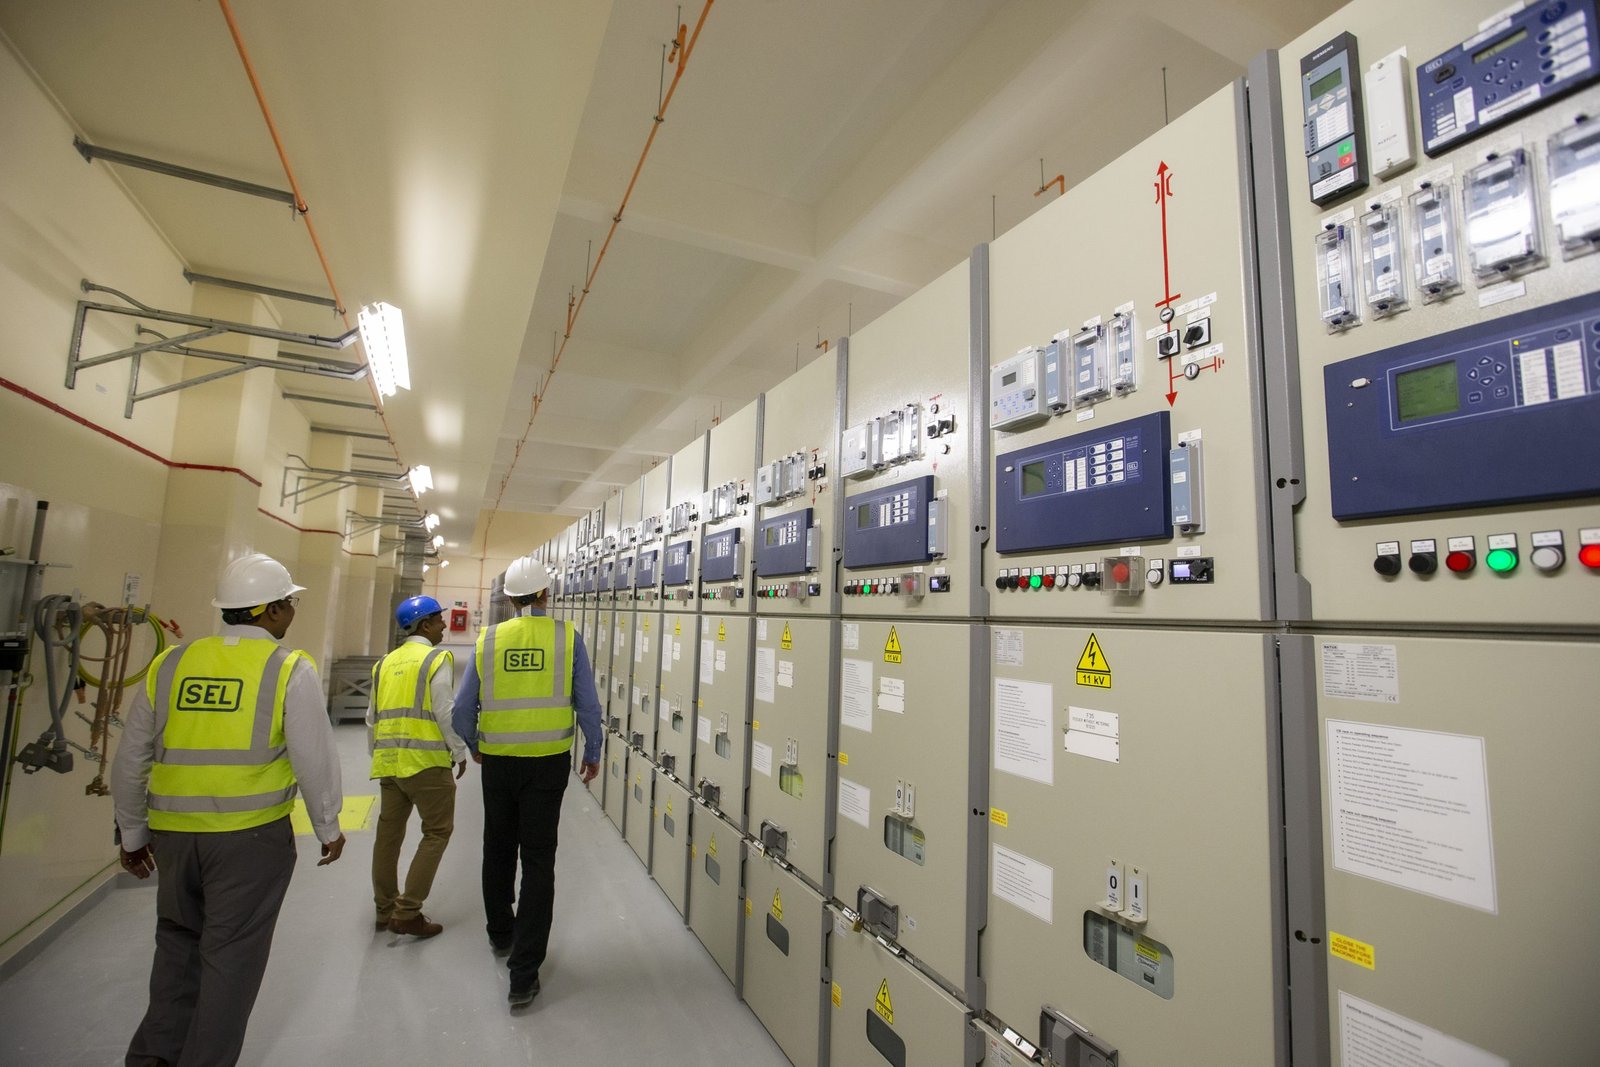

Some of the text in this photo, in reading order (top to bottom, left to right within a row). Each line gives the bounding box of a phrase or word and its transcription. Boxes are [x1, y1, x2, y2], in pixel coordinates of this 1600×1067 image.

[509, 653, 539, 667] SEL
[1083, 674, 1105, 685] 11 kV
[185, 684, 232, 704] SEL
[1110, 875, 1117, 889] 0
